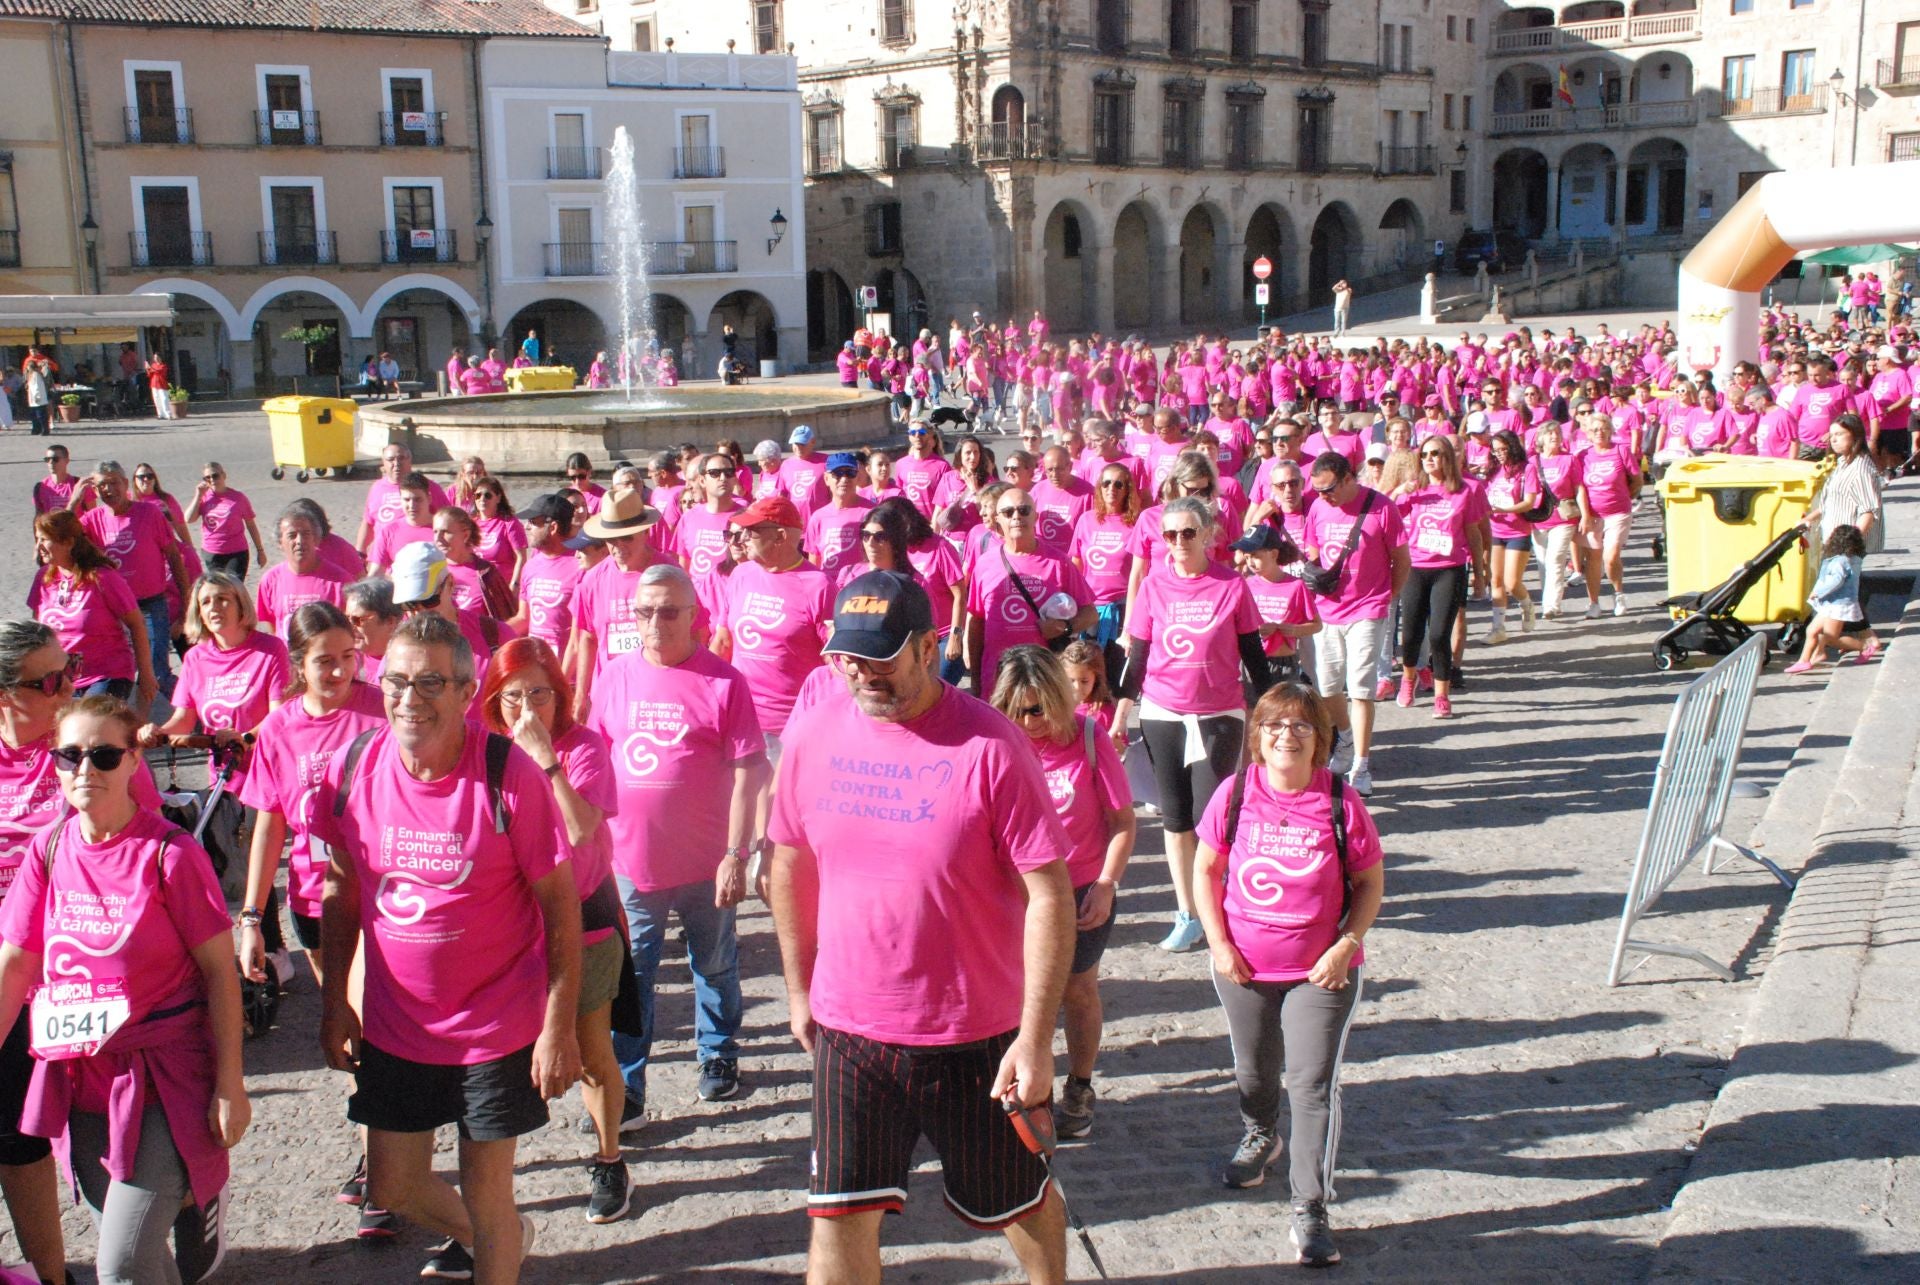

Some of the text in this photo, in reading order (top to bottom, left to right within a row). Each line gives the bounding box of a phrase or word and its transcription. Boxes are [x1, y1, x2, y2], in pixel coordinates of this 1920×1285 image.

[840, 596, 889, 614] KTM
[616, 636, 644, 651] 183
[639, 701, 684, 711] En marcha
[639, 710, 682, 720] contra el
[639, 718, 682, 732] cáncer
[830, 756, 913, 780] MARCHA
[831, 780, 904, 801] CONTRA
[816, 798, 913, 823] EL CÁNCER
[397, 827, 463, 842] En marcha
[1263, 822, 1320, 837] En marcha
[1262, 833, 1318, 846] contra el
[397, 840, 462, 855] contra el
[1261, 844, 1315, 860] cáncer
[396, 852, 462, 872] cáncer
[63, 904, 123, 918] contra el
[60, 915, 123, 936] cáncer
[46, 1010, 109, 1041] 0541
